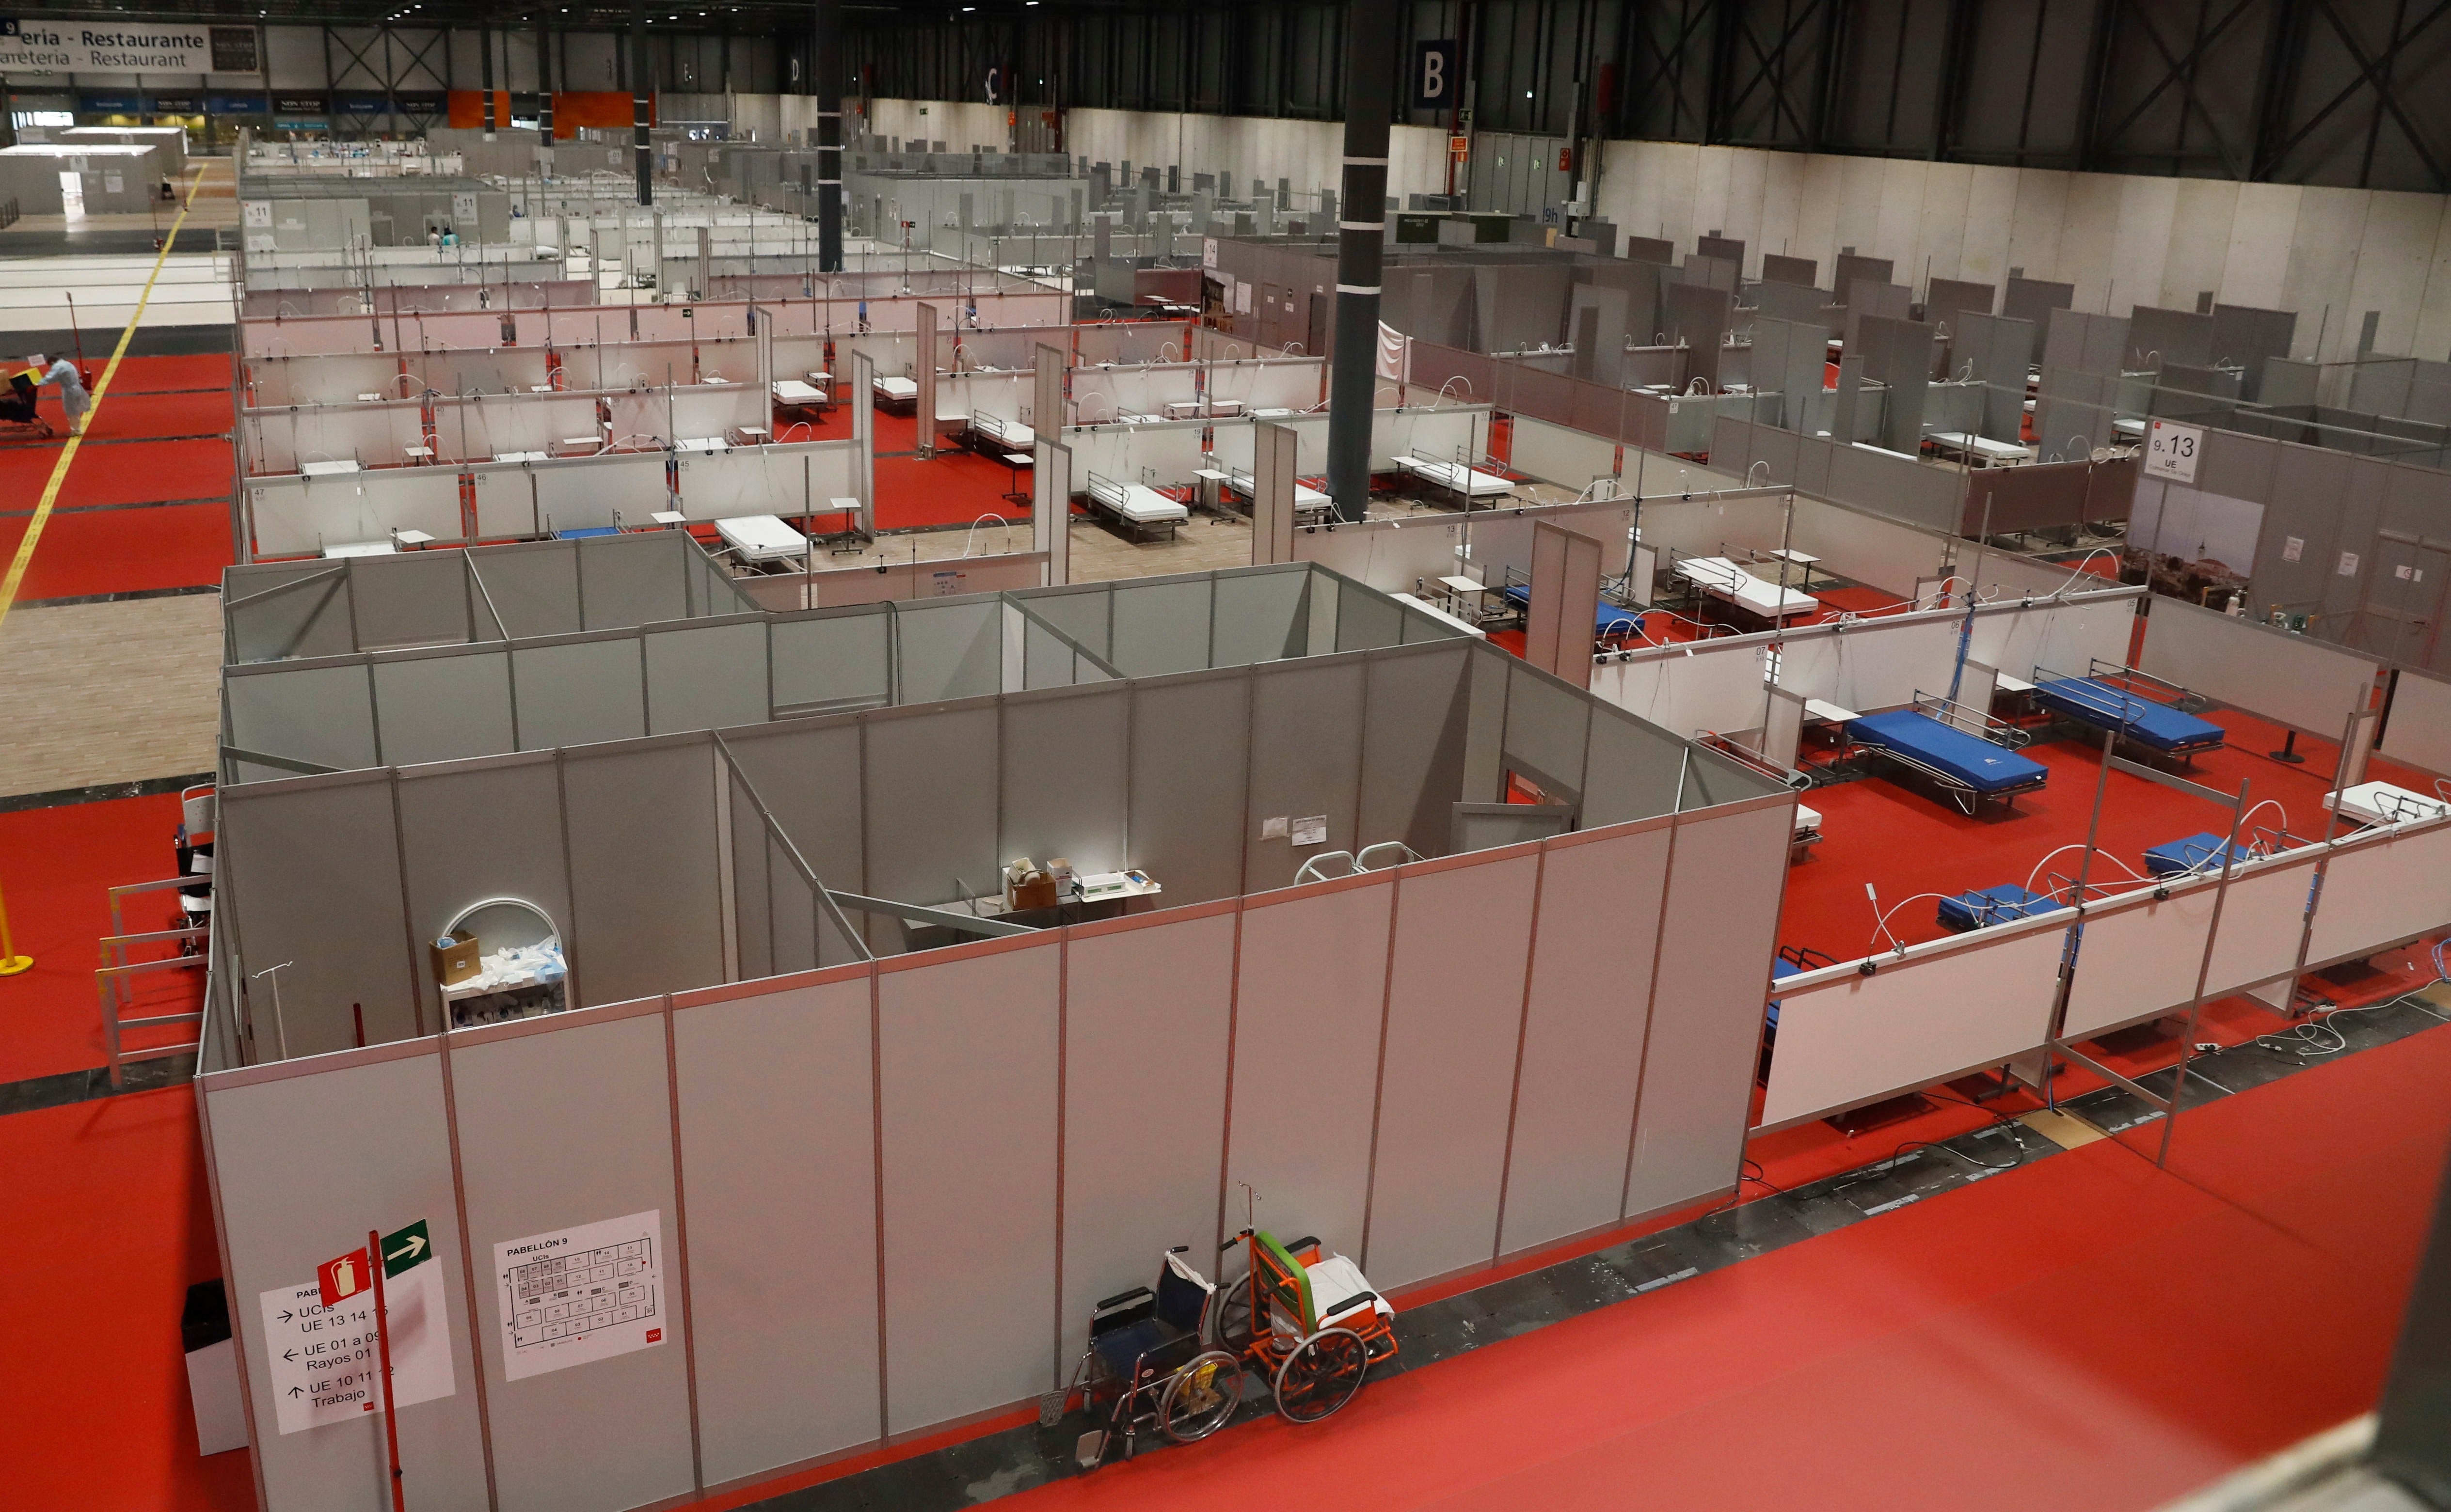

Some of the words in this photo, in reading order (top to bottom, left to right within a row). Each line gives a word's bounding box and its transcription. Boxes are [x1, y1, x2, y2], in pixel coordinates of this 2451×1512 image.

[5, 22, 15, 34] 9
[81, 31, 204, 48] Restaurante
[91, 49, 186, 67] Restaurant
[792, 59, 799, 81] D
[1423, 51, 1444, 98] B
[988, 68, 997, 99] C
[2165, 459, 2177, 469] UE
[2127, 599, 2136, 607] 05
[1951, 621, 1959, 629] 06
[1756, 646, 1766, 656] 07
[507, 1239, 559, 1257] PABELLÓN
[301, 1319, 323, 1333] UE
[328, 1315, 345, 1327] 13
[350, 1310, 367, 1322] 14
[304, 1342, 327, 1356] UE
[331, 1338, 347, 1351] 01
[352, 1337, 361, 1346] a
[306, 1354, 351, 1371] Rayos
[355, 1348, 371, 1360] 01
[310, 1380, 332, 1394] UE
[336, 1375, 353, 1387] 10
[358, 1371, 372, 1382] 11
[378, 1366, 395, 1376] 2
[311, 1389, 365, 1408] Trabajo
